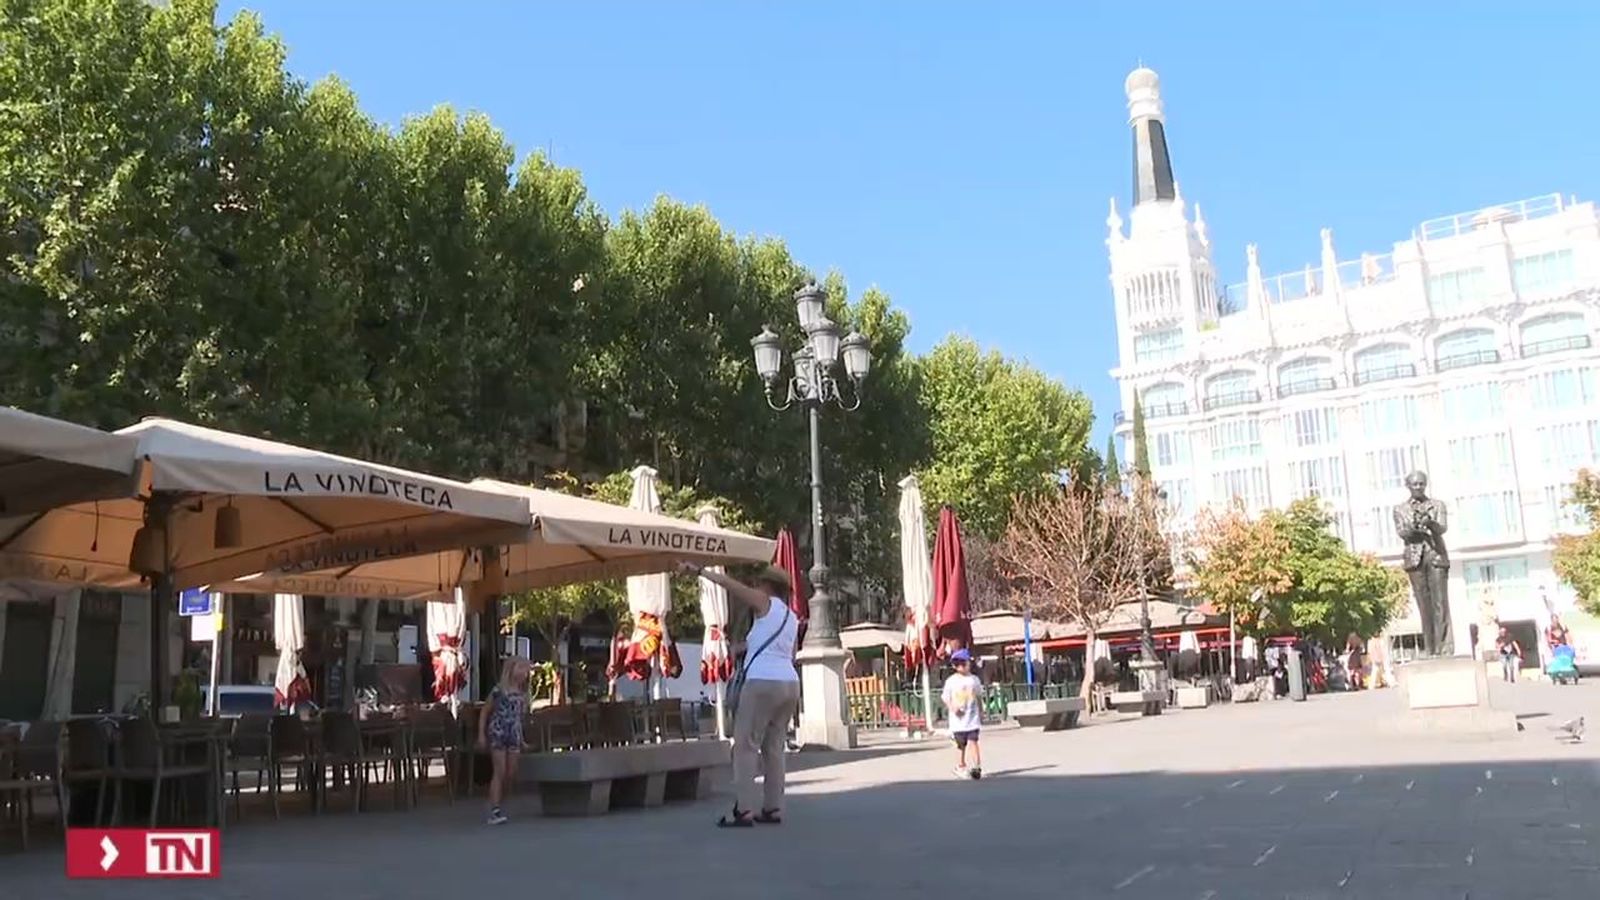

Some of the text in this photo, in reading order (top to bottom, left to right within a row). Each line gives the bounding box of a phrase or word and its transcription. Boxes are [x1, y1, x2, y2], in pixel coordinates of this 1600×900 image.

[264, 471, 453, 510] LA VINOTECA
[608, 527, 728, 554] LA VINOTECA
